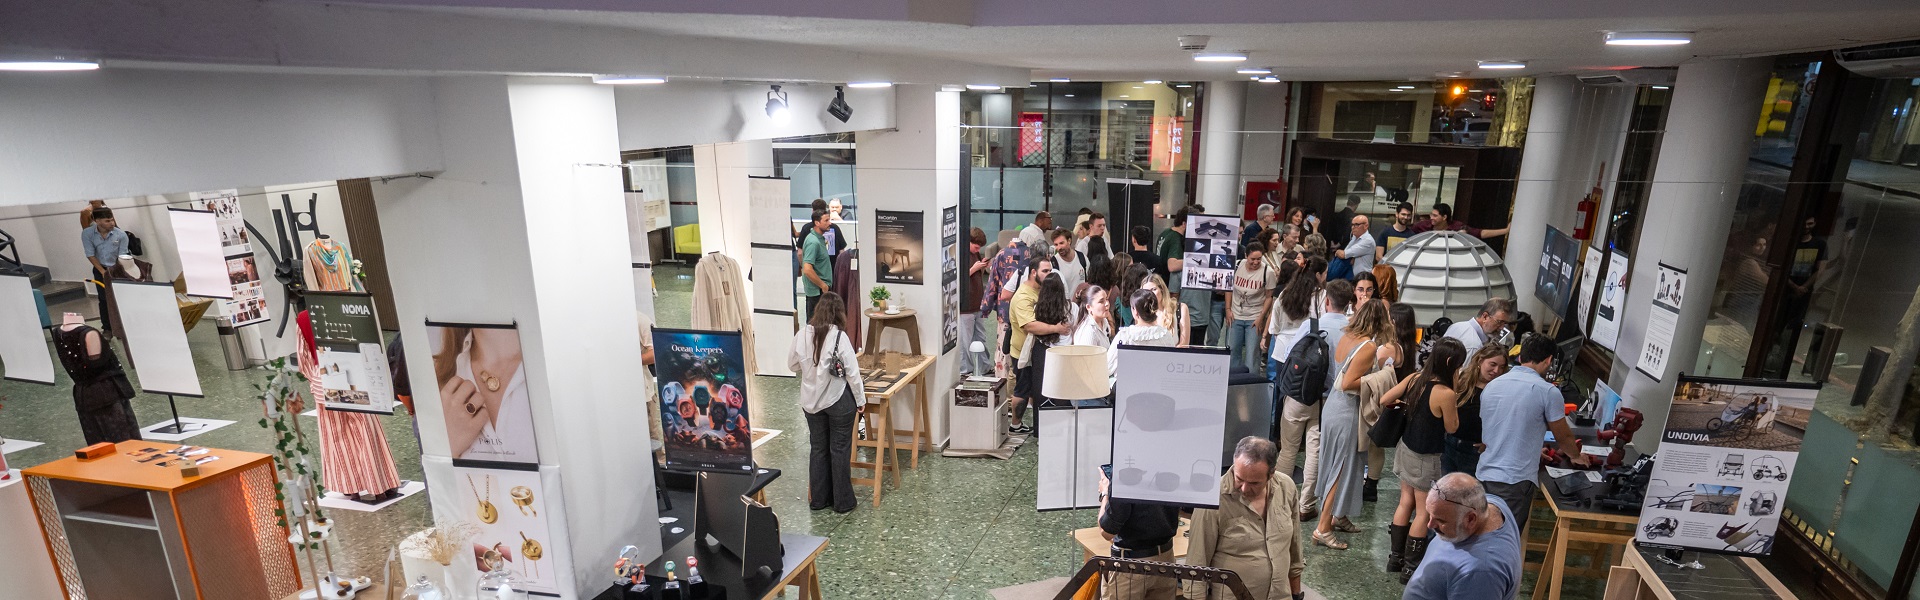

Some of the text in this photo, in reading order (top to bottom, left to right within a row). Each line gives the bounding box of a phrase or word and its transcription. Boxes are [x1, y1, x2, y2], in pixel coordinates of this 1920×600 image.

[1235, 275, 1263, 290] NIRVANA
[341, 304, 371, 315] NOMA
[671, 344, 724, 354] Ocean Keepers
[1667, 431, 1710, 442] UNDIVIA
